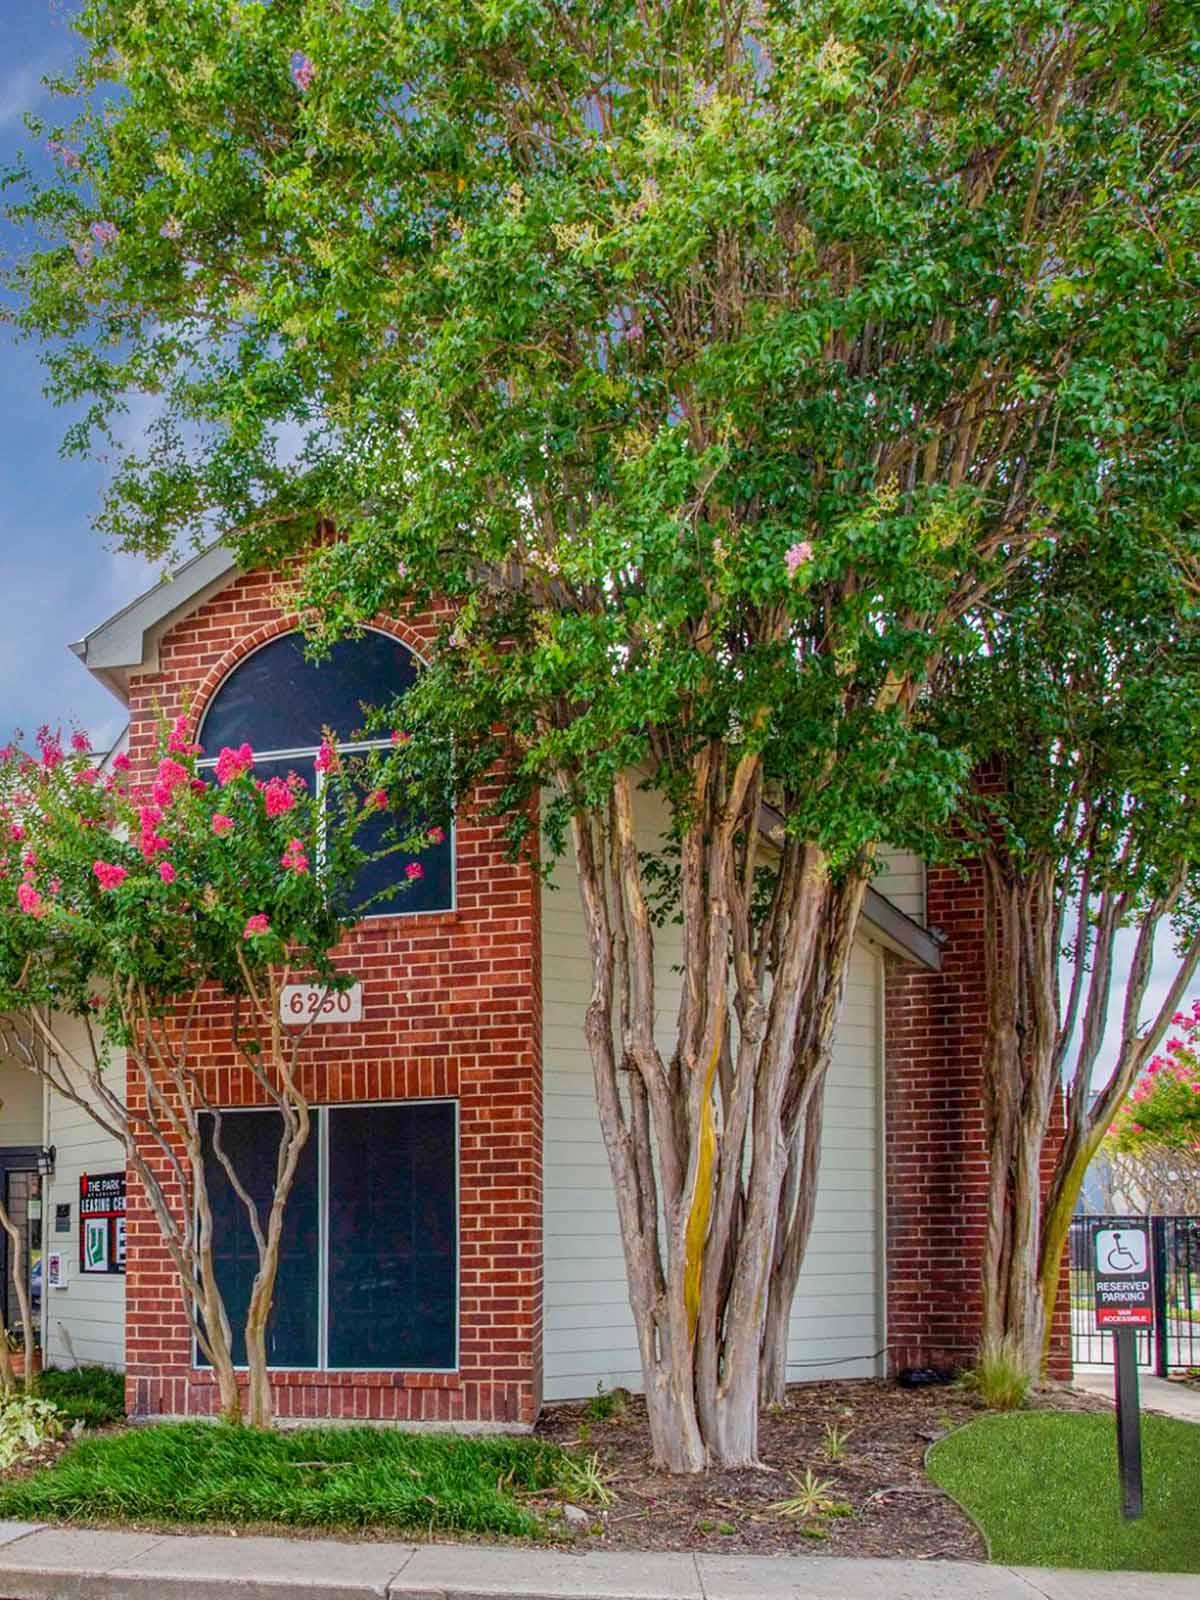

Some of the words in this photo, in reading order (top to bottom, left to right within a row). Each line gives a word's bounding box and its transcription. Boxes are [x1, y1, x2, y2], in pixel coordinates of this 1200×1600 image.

[290, 991, 351, 1014] 6250
[88, 1181, 101, 1192] THE
[102, 1179, 121, 1191] PARK
[81, 1198, 110, 1213] LEASING
[1096, 1281, 1150, 1291] RESERVED
[1102, 1291, 1145, 1302] PARKING
